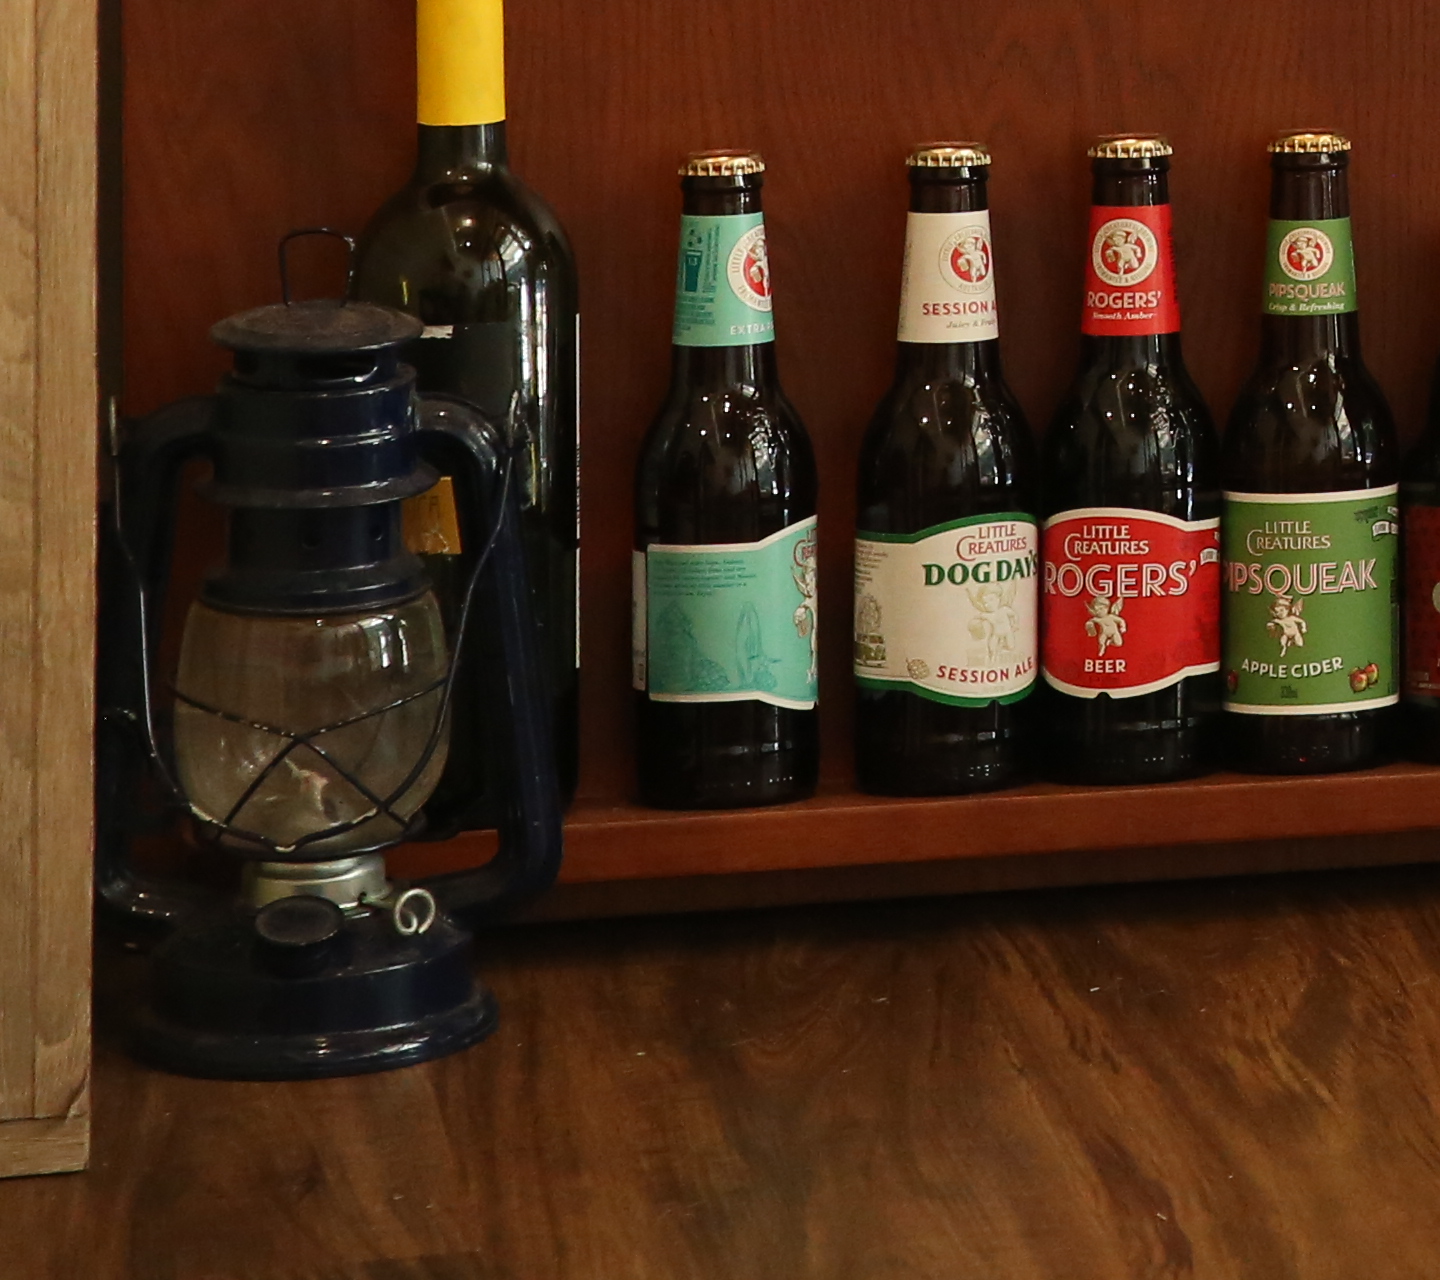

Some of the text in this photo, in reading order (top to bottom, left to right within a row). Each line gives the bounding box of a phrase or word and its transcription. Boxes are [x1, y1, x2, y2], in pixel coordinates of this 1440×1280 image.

[1269, 282, 1346, 303] PIPSQUEAK
[922, 301, 989, 316] SESSION
[978, 524, 1017, 539] LITTLE
[1083, 525, 1131, 539] LITTLE
[1265, 520, 1312, 534] LITTLE
[956, 535, 1027, 562] CREATURES
[1064, 533, 1150, 561] CREATURES
[1246, 529, 1331, 556] CREATURES
[922, 561, 992, 586] DOG
[1224, 558, 1377, 599] IPSQUEAK
[936, 656, 1033, 684] SESSION ALE
[1084, 659, 1127, 673] BEER
[1241, 656, 1344, 678] APPLE CIDER
